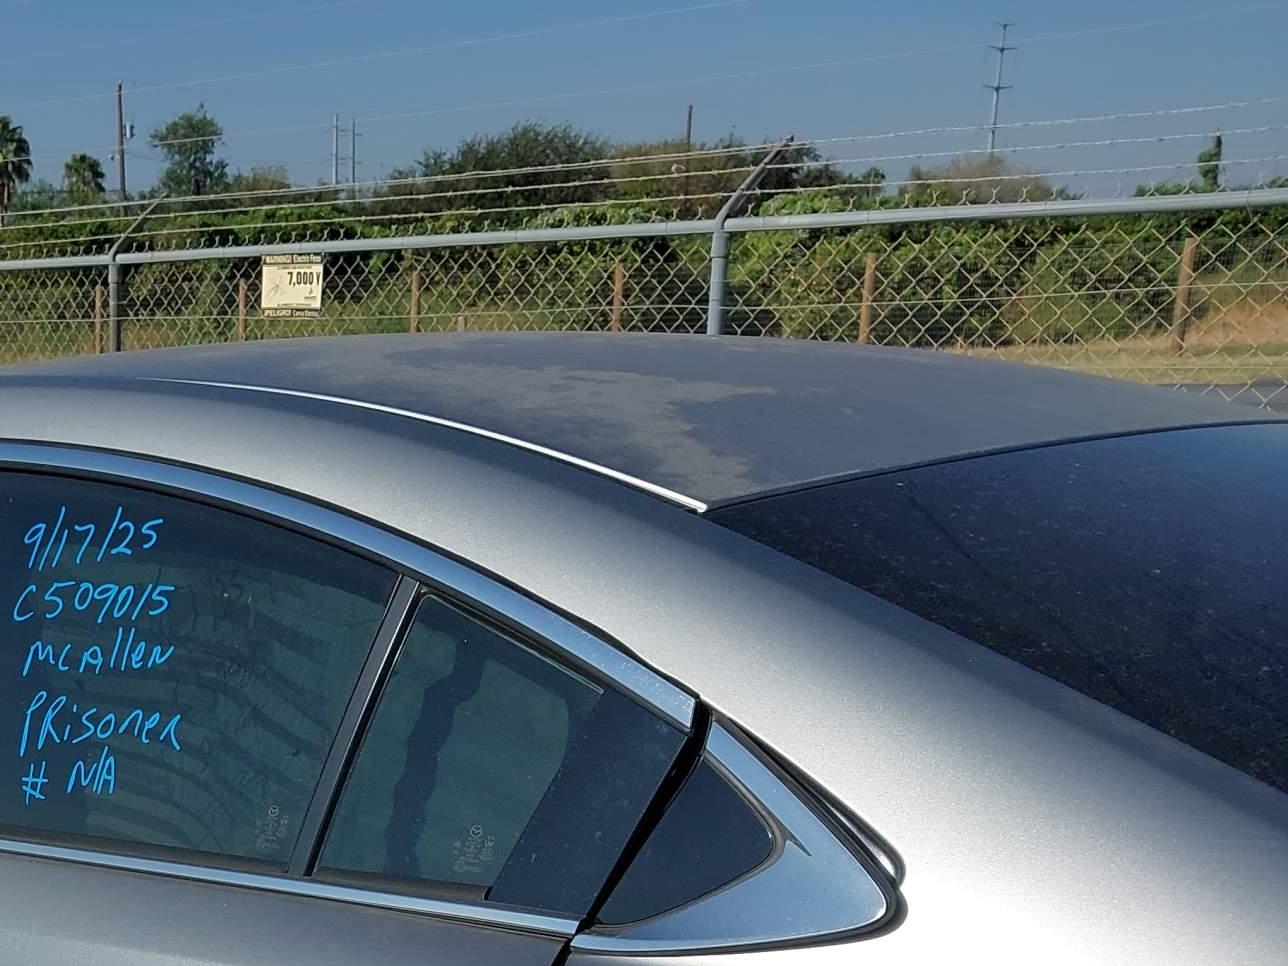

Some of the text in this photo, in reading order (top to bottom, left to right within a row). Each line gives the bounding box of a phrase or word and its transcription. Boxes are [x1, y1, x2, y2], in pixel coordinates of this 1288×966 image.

[287, 271, 314, 287] 7,000
[23, 506, 164, 571] 9/17/25
[21, 746, 116, 805] # N/A
